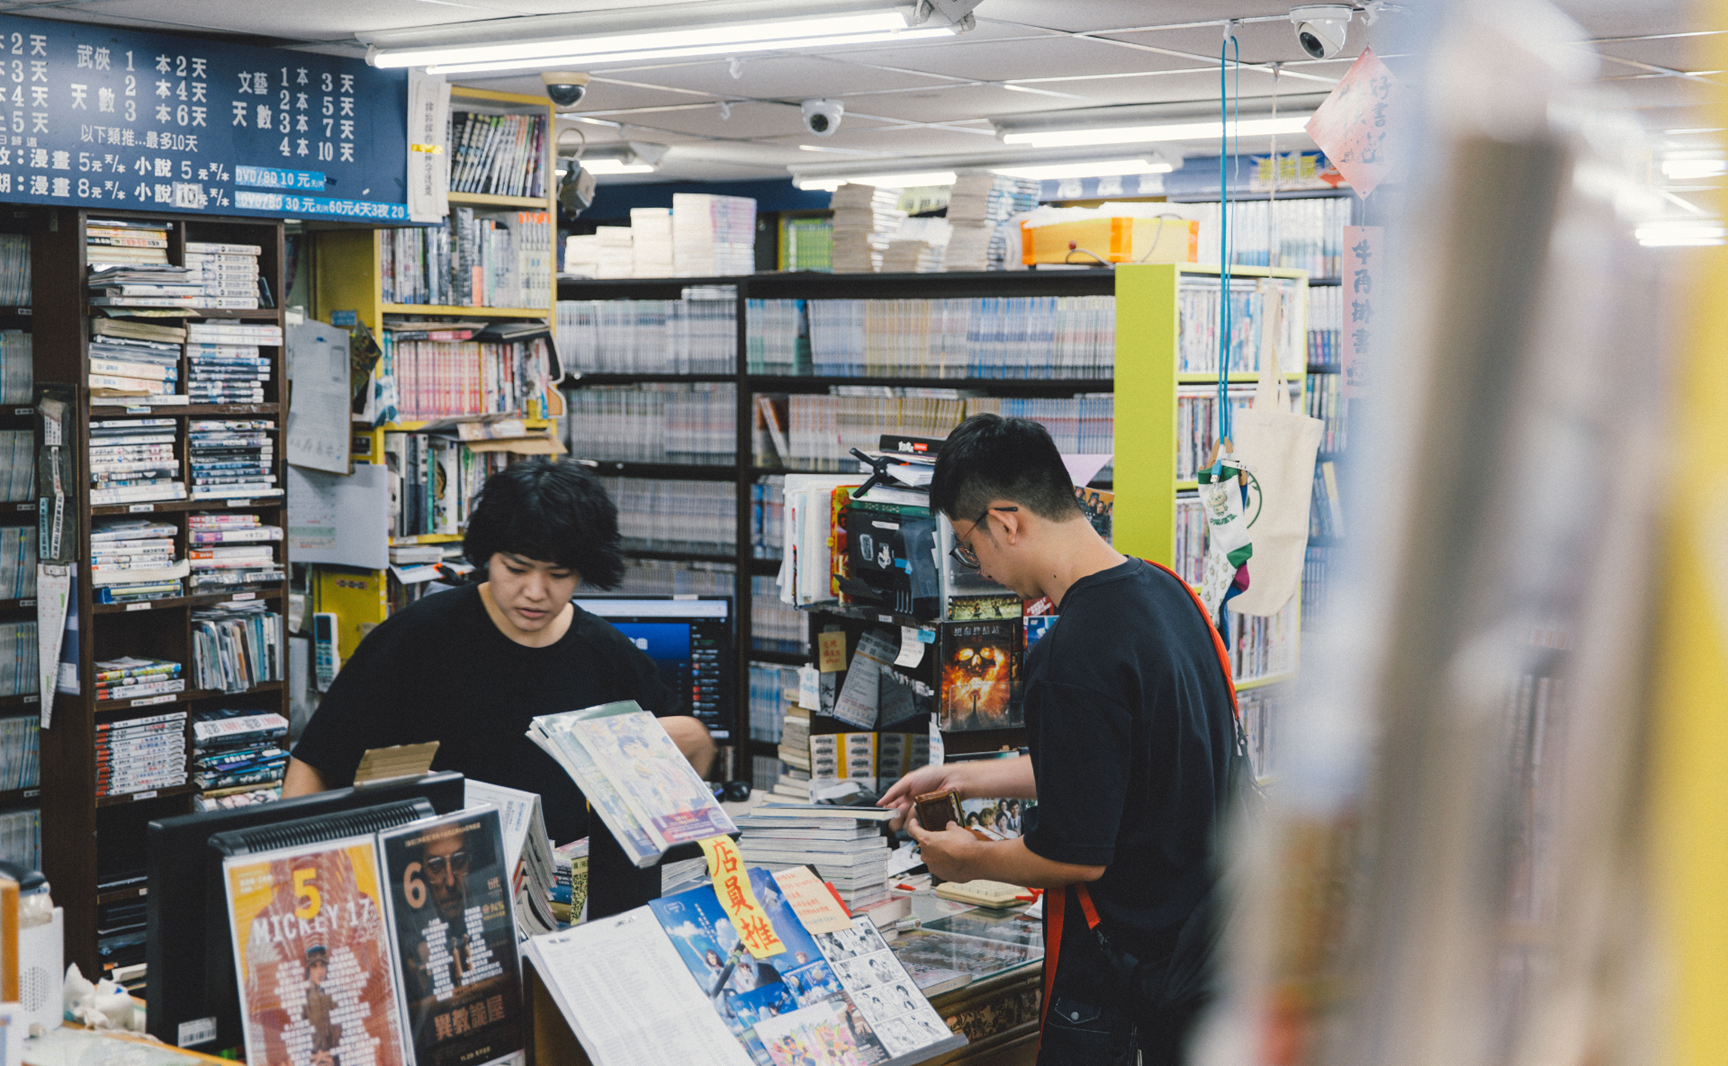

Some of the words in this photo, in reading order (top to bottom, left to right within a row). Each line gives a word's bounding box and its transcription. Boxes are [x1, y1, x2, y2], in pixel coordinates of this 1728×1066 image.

[77, 44, 111, 71] 武俠
[237, 70, 269, 96] 文藝
[134, 156, 172, 178] 小說
[134, 182, 172, 203] 小說
[293, 867, 321, 920] 5
[403, 861, 427, 909] 6
[712, 839, 780, 952] 店員推
[252, 904, 338, 946] MICKEY
[346, 898, 371, 927] 17
